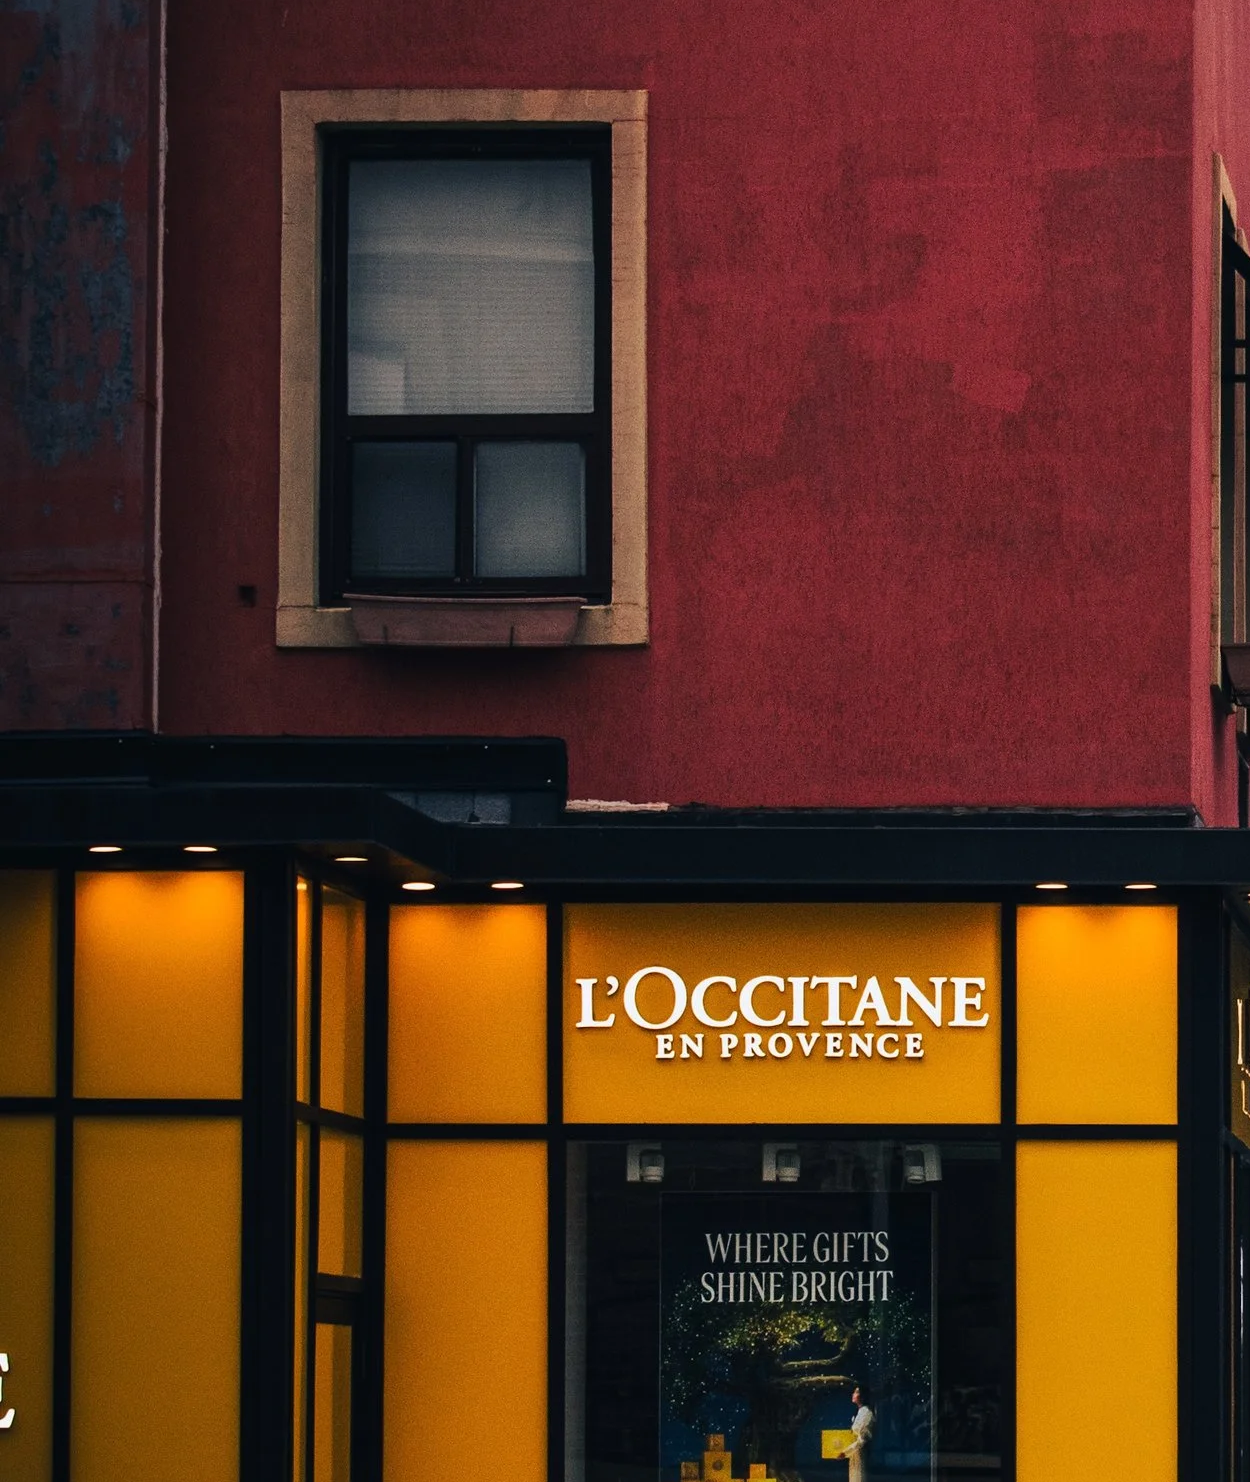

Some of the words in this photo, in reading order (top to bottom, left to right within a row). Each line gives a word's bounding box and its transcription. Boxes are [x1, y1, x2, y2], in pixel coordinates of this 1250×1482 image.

[575, 966, 989, 1030] L'OCCITANE
[655, 1032, 704, 1059] EN
[720, 1031, 925, 1058] PROVENCE
[705, 1231, 808, 1265] WHERE
[812, 1230, 890, 1264] GIFTS
[700, 1270, 785, 1305] SHINE
[790, 1269, 894, 1304] BRIGHT
